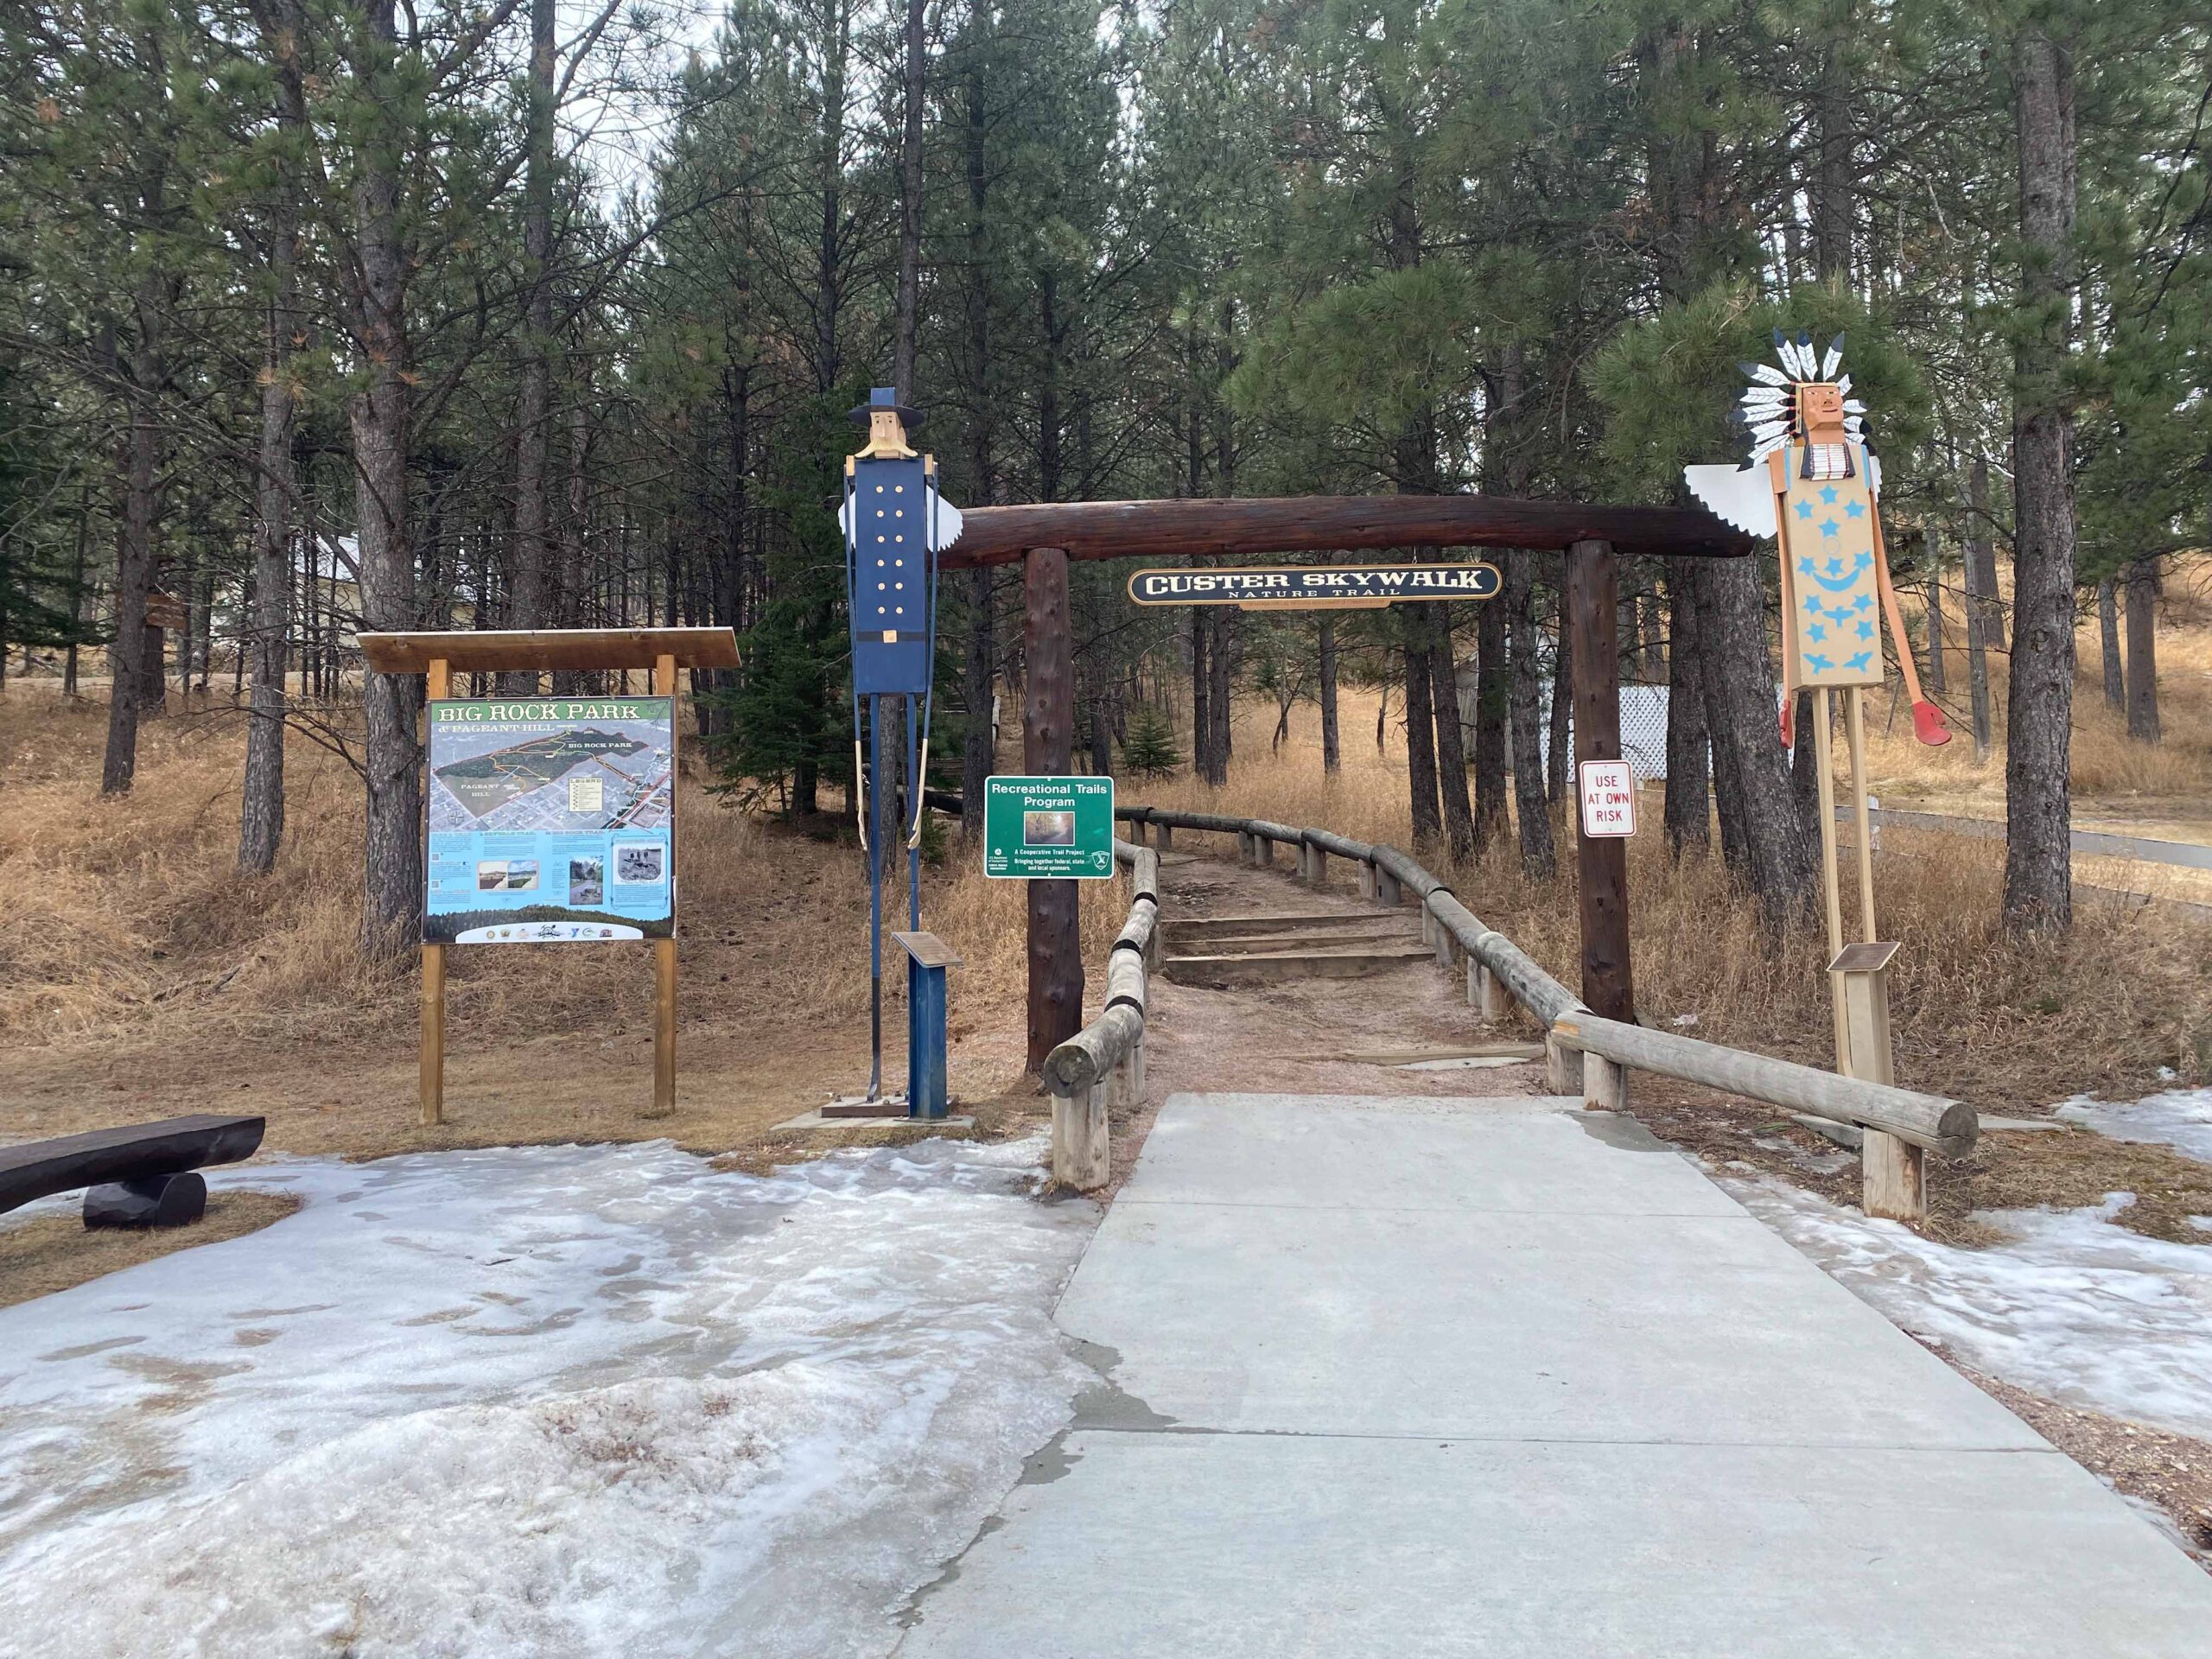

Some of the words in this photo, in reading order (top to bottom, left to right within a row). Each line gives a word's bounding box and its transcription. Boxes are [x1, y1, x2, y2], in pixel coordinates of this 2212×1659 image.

[1146, 575, 1291, 594] CUSTER
[1302, 570, 1483, 591] SKYWALK
[1228, 590, 1318, 599] NATURE
[438, 706, 483, 721] BIG
[488, 703, 560, 721] ROCK
[567, 703, 641, 720] PARK
[452, 724, 519, 733] PAGEANT
[1596, 776, 1618, 787] USE
[992, 784, 1071, 794] Recreational
[1075, 784, 1107, 794] Trails
[1024, 797, 1075, 808] Program
[1588, 793, 1600, 804] AT
[1606, 792, 1630, 804] OWN
[1596, 810, 1623, 822] RISK
